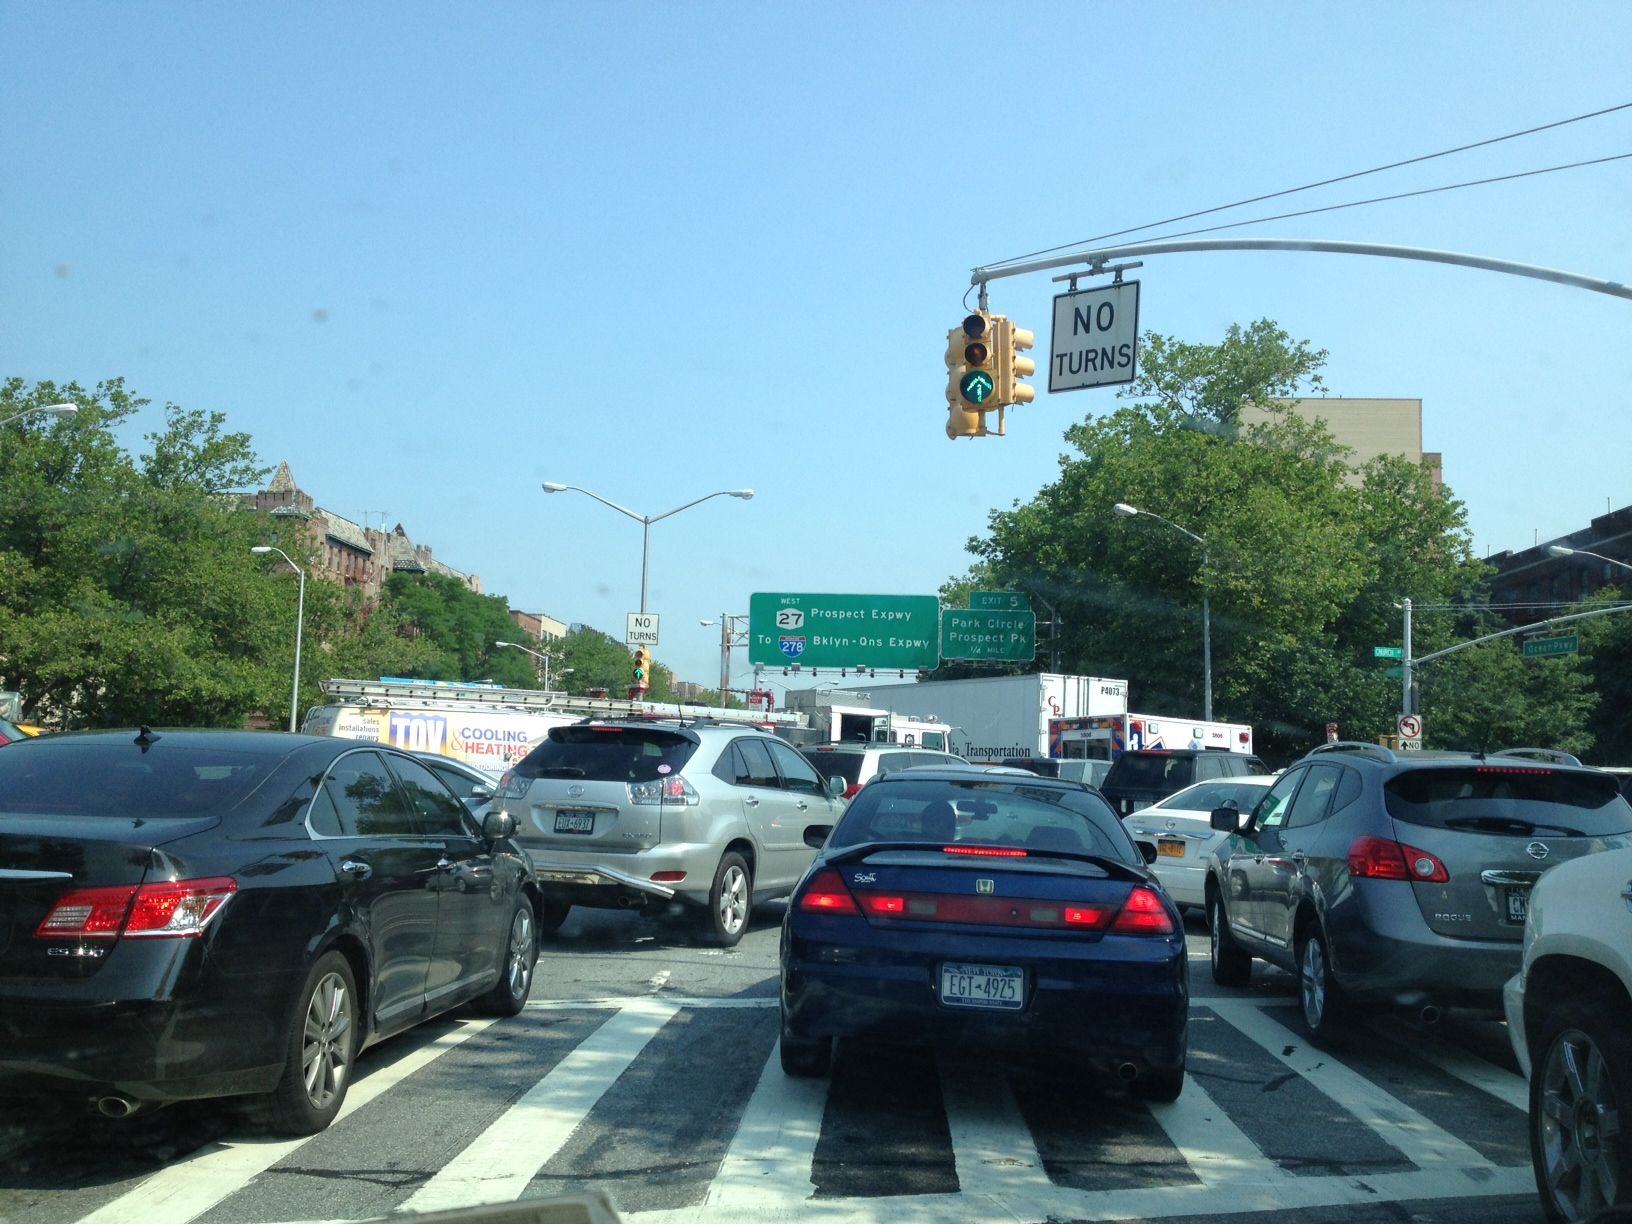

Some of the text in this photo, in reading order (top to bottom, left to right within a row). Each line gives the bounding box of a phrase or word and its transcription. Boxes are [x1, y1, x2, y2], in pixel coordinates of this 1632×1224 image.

[1073, 301, 1115, 336] NO
[1055, 343, 1131, 377] TURNS
[982, 596, 1018, 607] EXIT 5
[779, 612, 803, 626] 27
[811, 608, 912, 621] Prospect Expwy
[635, 617, 651, 628] NO
[951, 617, 1024, 629] Park Circle
[629, 631, 657, 641] TURNS
[949, 632, 1026, 643] Prospect Pk
[757, 634, 772, 644] To
[782, 641, 803, 652] 278
[889, 637, 929, 650] Expwy
[1101, 686, 1120, 696] P4073
[362, 717, 380, 725] sales
[338, 724, 380, 733] installations
[461, 727, 528, 743] COOLING
[464, 741, 528, 757] HEATING
[1408, 741, 1420, 750] NO
[965, 742, 1031, 761] Transportation
[1434, 913, 1472, 922] ROGUE
